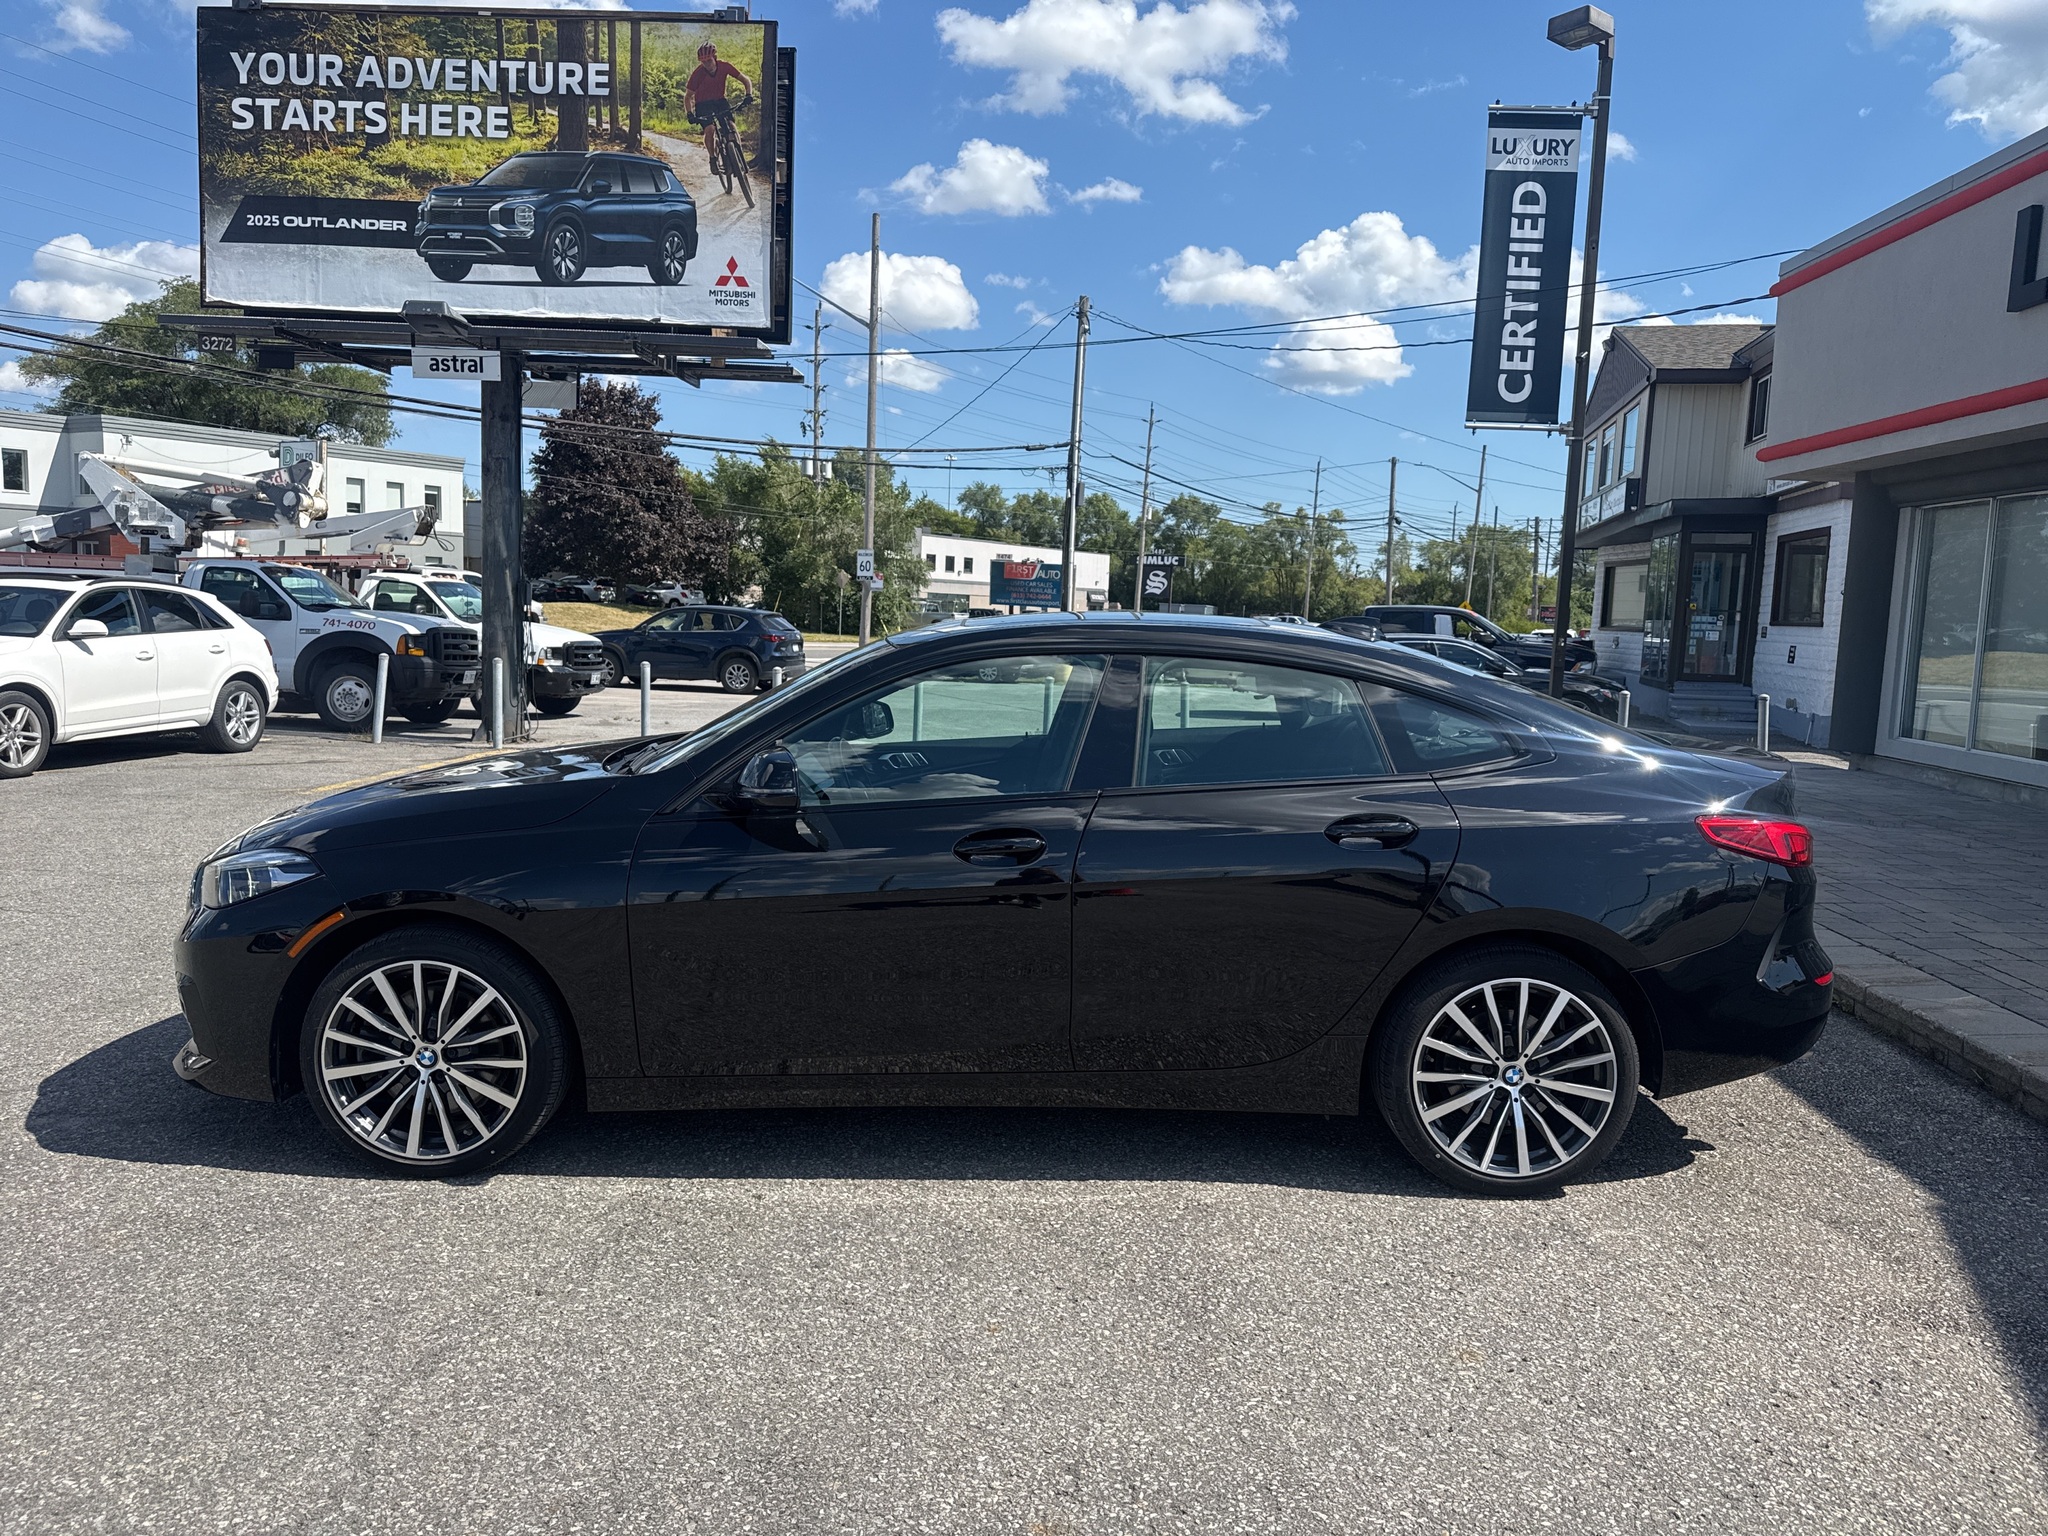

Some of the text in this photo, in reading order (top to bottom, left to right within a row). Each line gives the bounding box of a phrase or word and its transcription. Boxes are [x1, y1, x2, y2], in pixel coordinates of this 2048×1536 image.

[229, 51, 611, 97] YOUR ADVENTURE
[230, 97, 509, 139] STARTS HERE
[1491, 134, 1576, 158] LUXURY
[1505, 157, 1569, 167] AUTO IMPORTS
[246, 214, 408, 232] 2025 OUTLANDER
[708, 289, 757, 299] MITSUBISHI
[1497, 180, 1548, 404] CERTIFIED
[714, 298, 750, 307] MOTORS
[201, 336, 234, 351] 3272
[428, 354, 484, 374] astral
[859, 560, 872, 572] 60
[1036, 569, 1061, 580] AUTO
[322, 617, 376, 630] 741-4070
